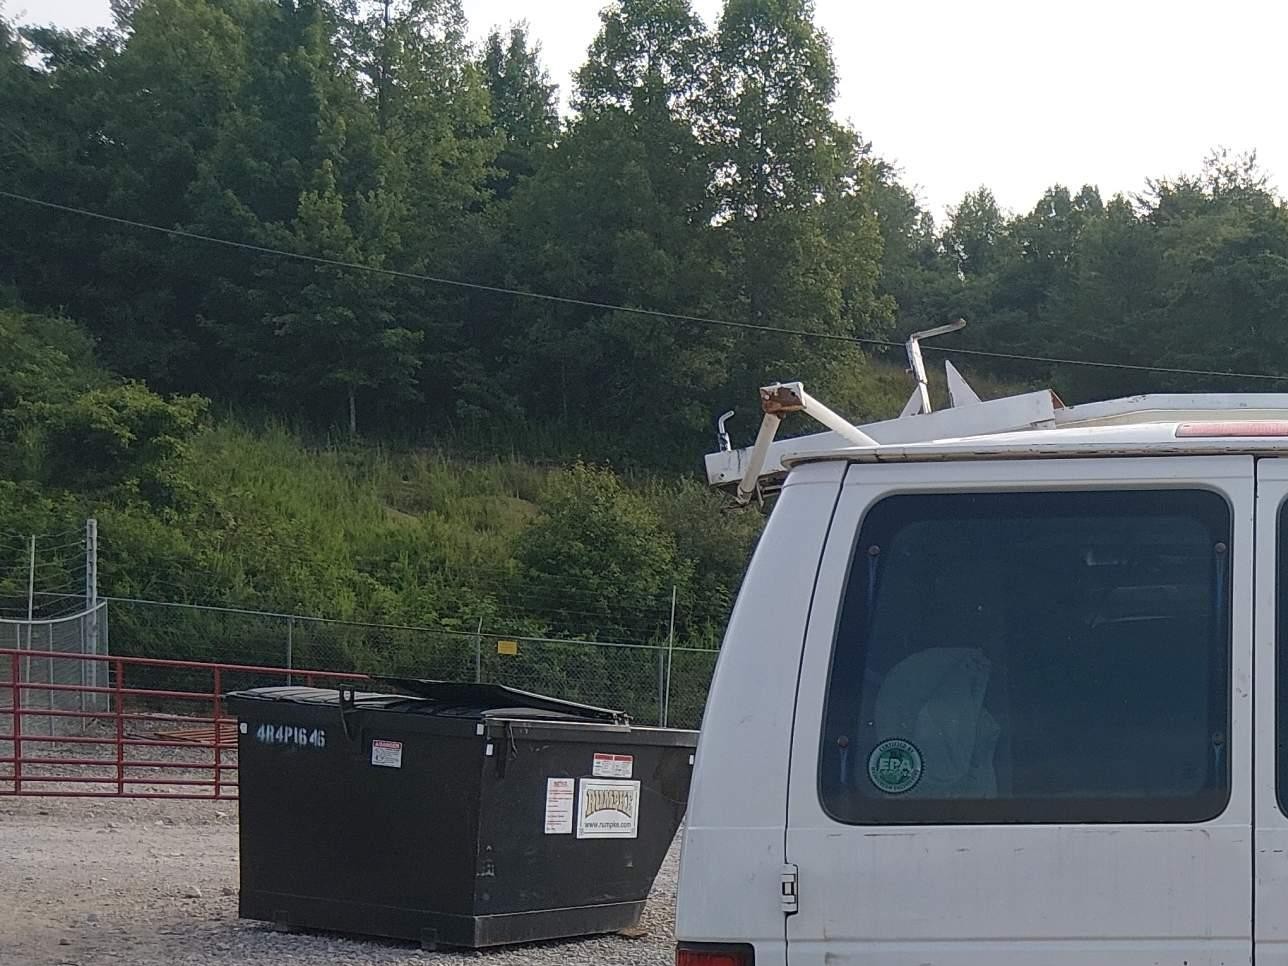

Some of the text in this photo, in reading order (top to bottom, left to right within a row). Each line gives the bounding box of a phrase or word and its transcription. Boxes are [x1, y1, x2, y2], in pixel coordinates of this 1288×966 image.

[880, 758, 912, 770] EPA
[585, 789, 633, 818] RUMPKE
[584, 821, 632, 830] www.rumpke.com
